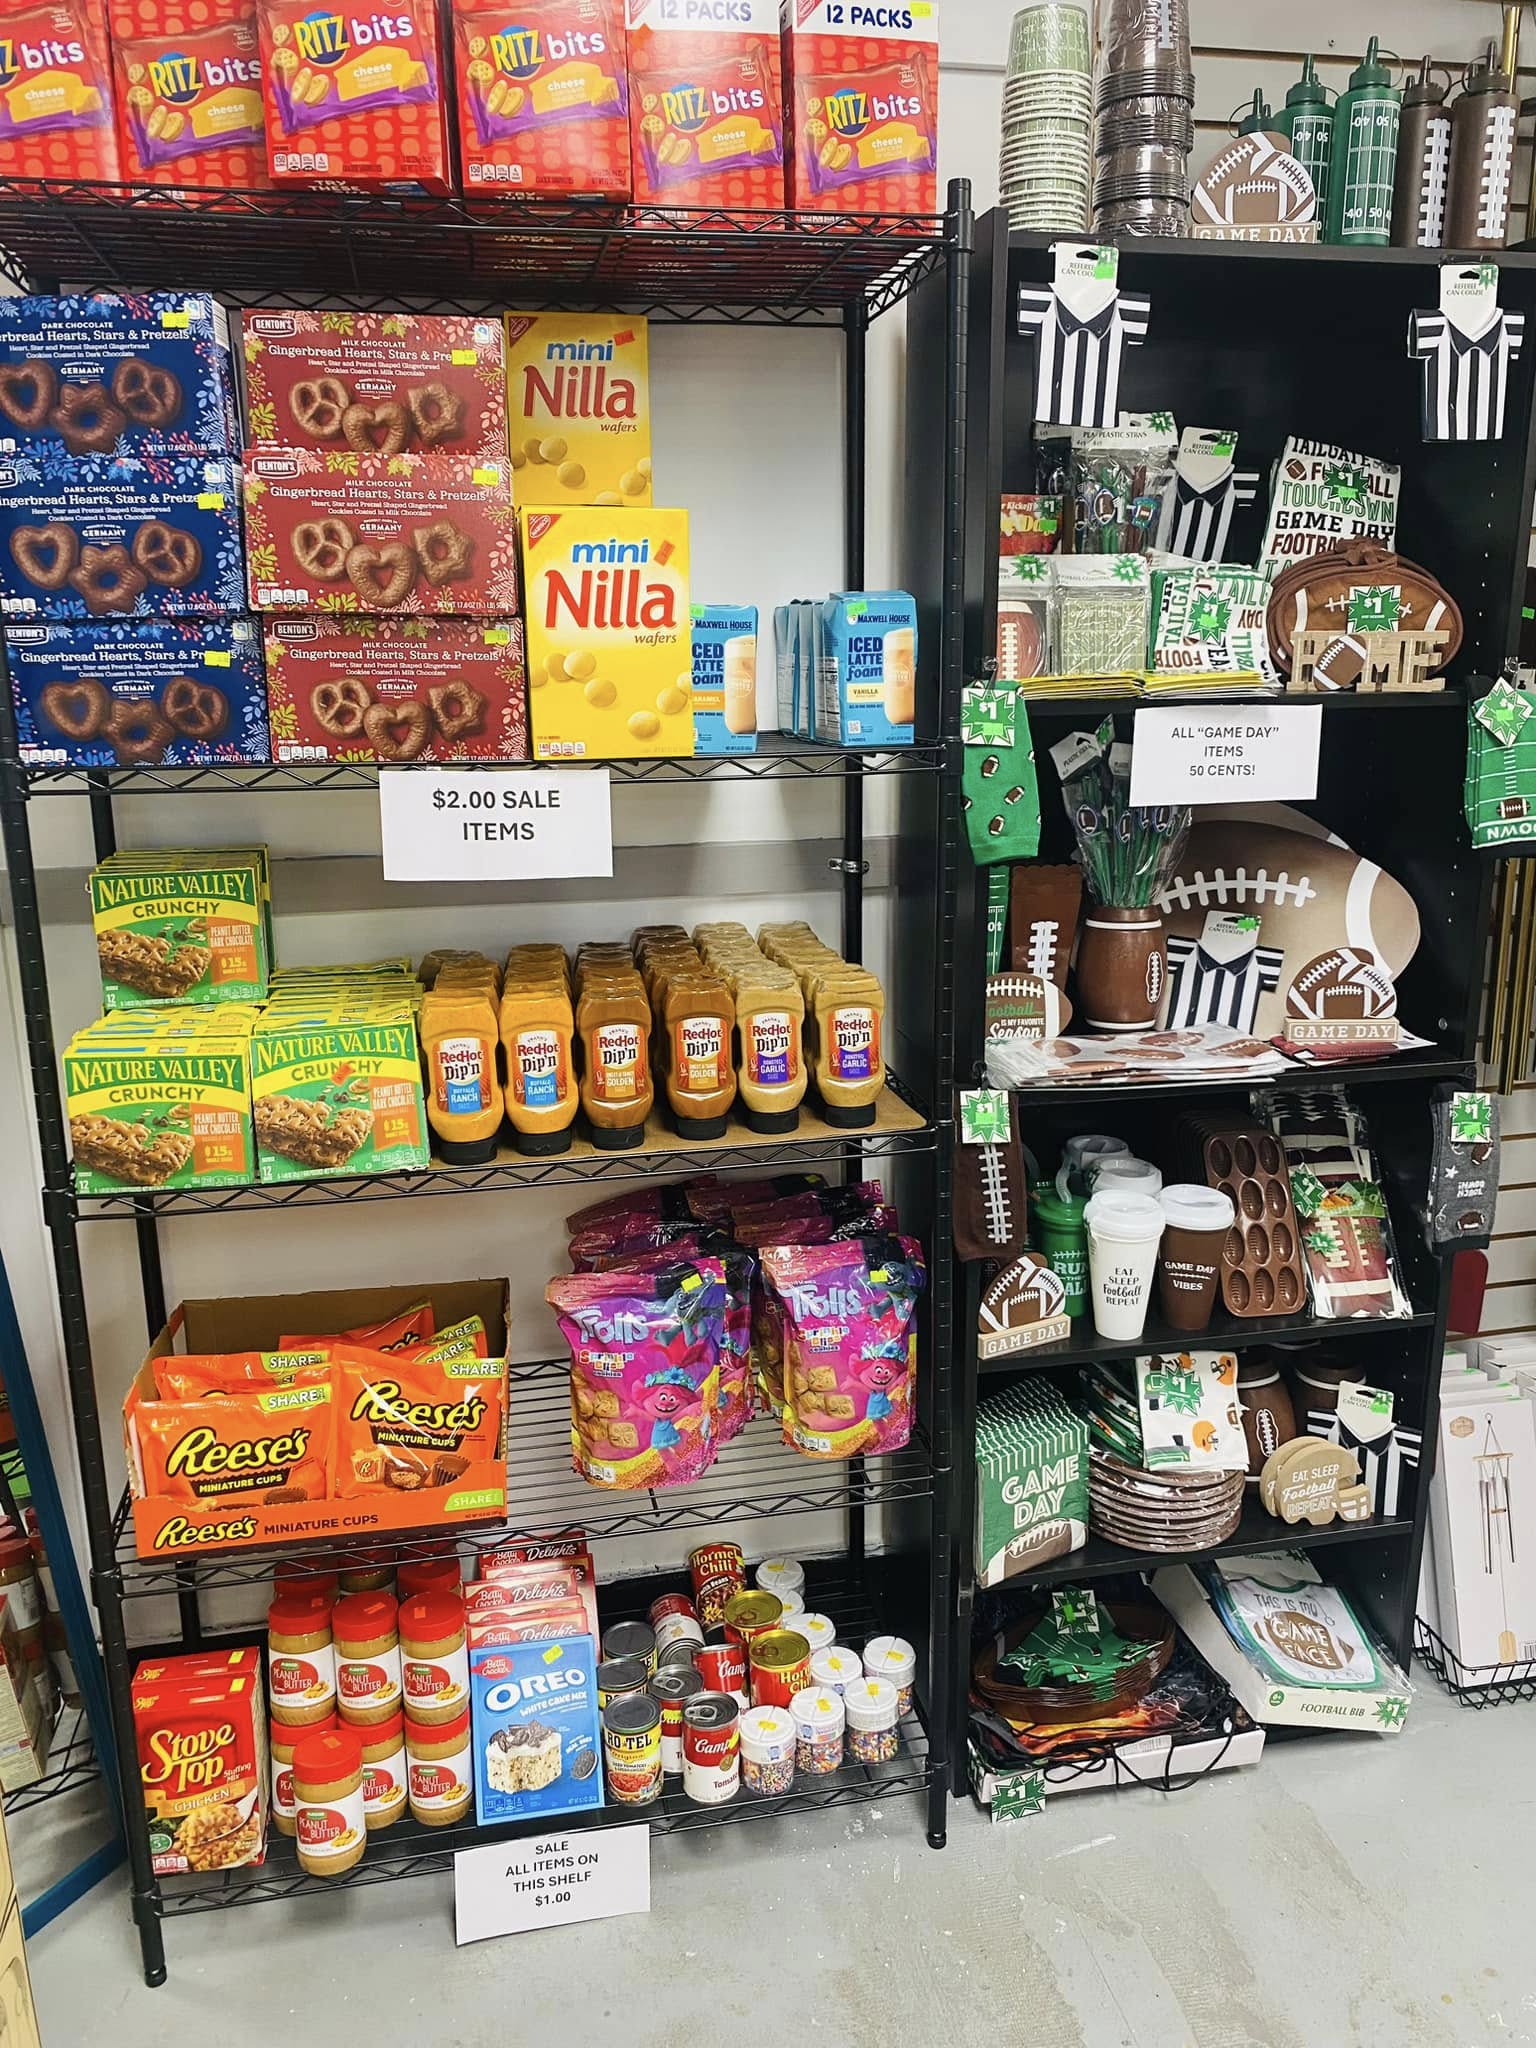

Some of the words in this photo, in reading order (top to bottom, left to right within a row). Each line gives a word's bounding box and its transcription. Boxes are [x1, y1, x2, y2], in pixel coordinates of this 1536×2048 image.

[825, 5, 845, 24] 12
[851, 7, 913, 30] PACKS
[293, 16, 350, 61] RITZ
[351, 14, 413, 46] bits
[21, 38, 84, 70] bits
[490, 30, 545, 72] RITZ
[545, 30, 606, 60] bits
[150, 56, 205, 98] RITZ
[204, 57, 261, 87] bits
[352, 62, 392, 79] cheese
[661, 85, 710, 124] RITZ
[711, 86, 764, 112] bits
[825, 91, 871, 127] RITZ
[872, 94, 921, 120] bits
[256, 319, 293, 330] BENTON'S
[47, 331, 91, 342] Hearts,
[94, 330, 125, 341] Stars
[129, 330, 139, 340] &
[142, 330, 190, 340] Pretzels
[547, 339, 614, 361] mini
[523, 365, 637, 419] Nilla
[600, 422, 637, 434] wafers
[1338, 472, 1352, 486] $1
[1276, 510, 1344, 533] GAME
[572, 539, 648, 564] mini
[1024, 563, 1038, 575] $1
[1120, 565, 1135, 577] $1
[544, 569, 677, 630] Nilla
[1364, 597, 1382, 613] $1
[858, 615, 888, 623] MAXWELL
[888, 615, 910, 623] HOUSE
[277, 625, 314, 635] BENTON'S
[634, 631, 677, 645] wafers
[848, 637, 883, 652] ICED
[290, 649, 363, 661] Gingerbread
[366, 650, 407, 661] Hearts,
[410, 651, 440, 660] Stars
[442, 651, 452, 661] &
[455, 651, 499, 661] Pretzels
[848, 654, 882, 665] LATTE
[847, 666, 882, 681] foam
[376, 683, 418, 691] GERMANY
[979, 701, 997, 720] $1
[1172, 727, 1194, 738] ALL
[1204, 746, 1244, 757] ITEMS
[1190, 765, 1203, 776] 50
[1207, 765, 1256, 776] CENTS!
[432, 788, 495, 810] $2.00
[503, 790, 560, 809] SALE
[463, 822, 535, 841] ITEMS
[98, 876, 177, 909] NATURE
[178, 873, 247, 901] VALLEY
[132, 901, 220, 918] CRUNCHY
[985, 1022, 1042, 1040] Season
[1294, 1025, 1348, 1040] GAME
[1354, 1025, 1392, 1038] DAY
[600, 1035, 639, 1048] RedHot
[440, 1050, 482, 1063] RedHot
[603, 1047, 636, 1065] Dip'n
[70, 1059, 158, 1092] NATURE
[158, 1058, 239, 1088] VALLEY
[445, 1062, 480, 1081] Dip'n
[761, 1064, 786, 1073] GARLIC
[606, 1077, 634, 1087] GOLDEN
[109, 1087, 206, 1103] CRUNCHY
[450, 1093, 478, 1103] RANCH
[194, 1112, 215, 1122] PEANUT
[216, 1113, 240, 1123] BUTTER
[1465, 1103, 1478, 1119] $1
[194, 1122, 209, 1135] DARK
[210, 1122, 242, 1135] CHOCOLATE
[1115, 1267, 1133, 1275] EAT
[1165, 1261, 1193, 1270] GAME
[1196, 1265, 1216, 1274] DAY
[1108, 1276, 1139, 1285] SLEEP
[1172, 1280, 1203, 1290] VIBES
[1103, 1283, 1143, 1297] Football
[777, 1284, 861, 1322] Trolls
[1105, 1296, 1139, 1305] REPEAT
[569, 1309, 649, 1345] Trolls
[988, 1330, 1033, 1353] GAME
[1036, 1323, 1067, 1340] DAY
[450, 1363, 499, 1376] SHARE
[1172, 1377, 1186, 1392] $1
[351, 1382, 486, 1429] Reese's
[166, 1427, 312, 1478] Reese's
[1002, 1454, 1080, 1504] GAME
[1311, 1464, 1340, 1480] SLEEP
[199, 1478, 254, 1493] MINIATURE
[256, 1473, 283, 1486] CUPS
[1282, 1478, 1337, 1502] Football
[1013, 1487, 1065, 1529] DAY
[154, 1516, 258, 1549] Reese's
[264, 1517, 339, 1535] MINIATURE
[342, 1514, 379, 1527] CUPS
[692, 1549, 737, 1568] Hormel
[700, 1560, 732, 1576] Chili
[513, 1582, 566, 1602] Delights
[1254, 1593, 1280, 1610] THIS
[1284, 1598, 1295, 1611] IS
[1272, 1617, 1329, 1646] GAME
[1281, 1641, 1337, 1667] FACE
[486, 1669, 585, 1712] OREO
[520, 1701, 548, 1717] WHITE
[548, 1694, 570, 1706] CAKE
[572, 1691, 587, 1700] MIX
[1300, 1703, 1348, 1717] FOOTBALL
[1350, 1708, 1366, 1717] BIB
[1387, 1704, 1399, 1717] $1
[626, 1733, 652, 1750] TEL
[142, 1724, 236, 1784] Stove
[171, 1754, 224, 1793] Top
[1007, 1784, 1026, 1799] $1
[174, 1788, 231, 1813] CHICKEN
[299, 1818, 327, 1829] PEANUT
[310, 1827, 340, 1838] BUTTER
[535, 1841, 569, 1855] SALE
[505, 1864, 530, 1877] ALL
[533, 1857, 574, 1872] ITEMS
[578, 1853, 599, 1865] ON
[513, 1878, 545, 1893] THIS
[549, 1871, 592, 1887] SHELF
[535, 1892, 571, 1906] $1.00
